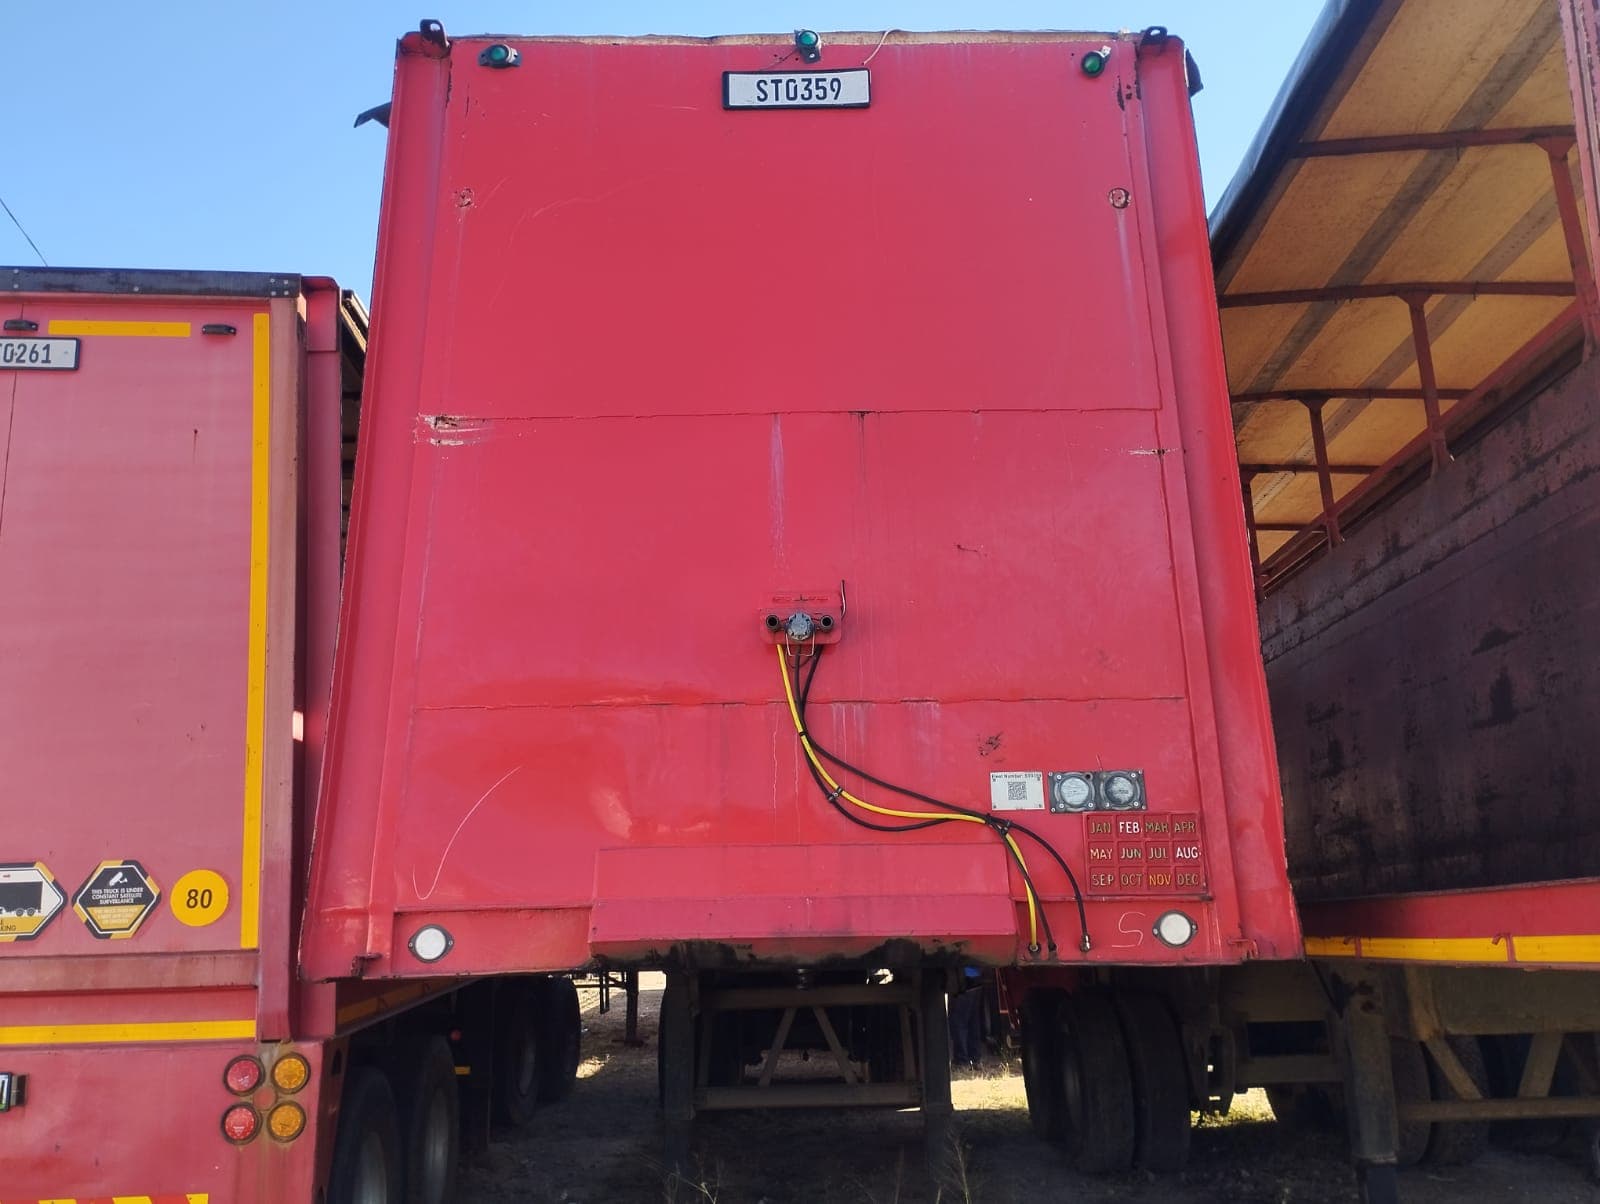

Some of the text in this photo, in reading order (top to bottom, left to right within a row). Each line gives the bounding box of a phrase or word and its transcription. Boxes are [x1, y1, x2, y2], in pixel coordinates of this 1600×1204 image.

[756, 77, 842, 102] ST0359
[1091, 821, 1195, 834] JAN FEB MAR APR
[1090, 846, 1198, 860] MAY JUN JUL AUG
[1092, 873, 1199, 886] SEP OCT NOV DEC
[186, 888, 213, 909] 80
